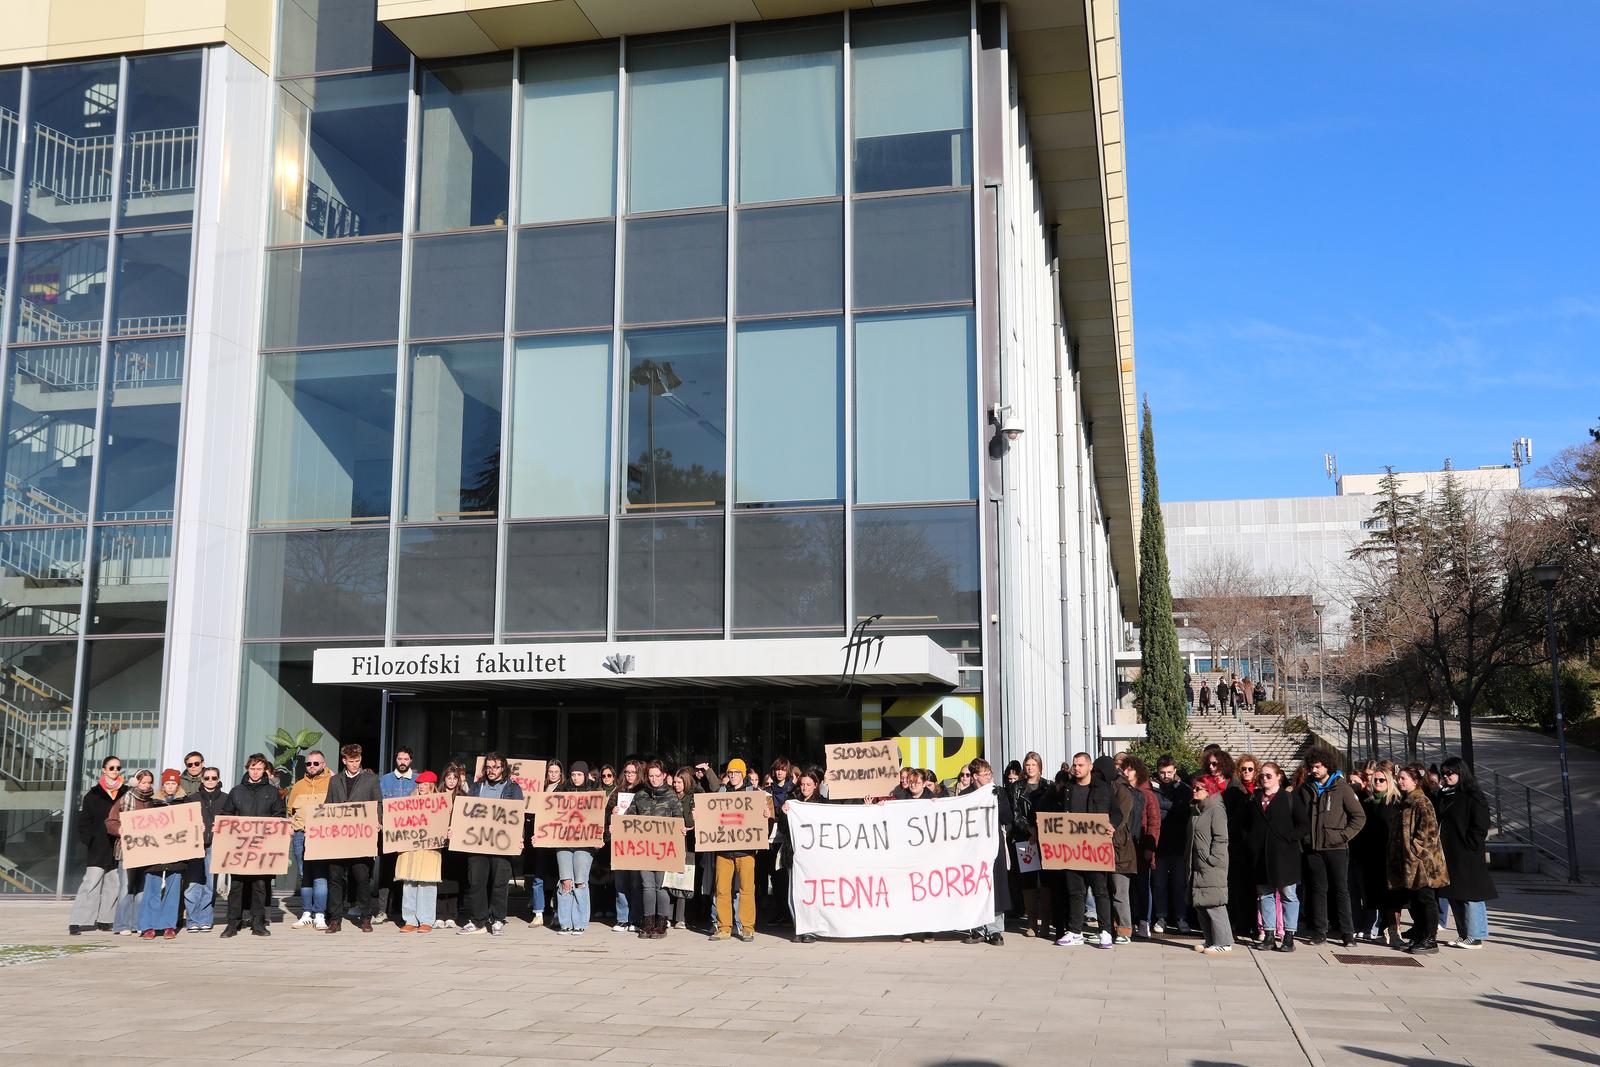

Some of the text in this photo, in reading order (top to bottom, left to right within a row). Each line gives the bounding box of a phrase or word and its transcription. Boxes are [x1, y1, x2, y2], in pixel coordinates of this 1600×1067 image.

[351, 652, 566, 676] Filozofski fakultet
[833, 745, 891, 760] SLOBODA
[313, 804, 367, 818] ŽIVJETI
[388, 796, 448, 813] KORUPCIJA
[545, 795, 604, 810] STUDENTI
[707, 796, 753, 811] OTPOR
[394, 813, 428, 828] VLADA
[492, 804, 520, 825] VAS
[555, 811, 585, 823] ZA
[216, 820, 292, 836] PROTEST
[309, 823, 373, 839] SLOBODNO
[537, 822, 604, 841] STUDENTE
[622, 819, 676, 835] PROTIV
[699, 826, 763, 844] DUŽNOST
[800, 805, 996, 850] JEDAN SVIJET
[1044, 817, 1108, 836] NE DAMO
[123, 834, 159, 851] BORI
[236, 836, 264, 849] JE
[385, 829, 428, 843] NAROD
[462, 826, 511, 851] SMO
[614, 840, 677, 861] NASILJA
[221, 851, 284, 868] ISPIT
[802, 860, 992, 909] JEDNA BORBA
